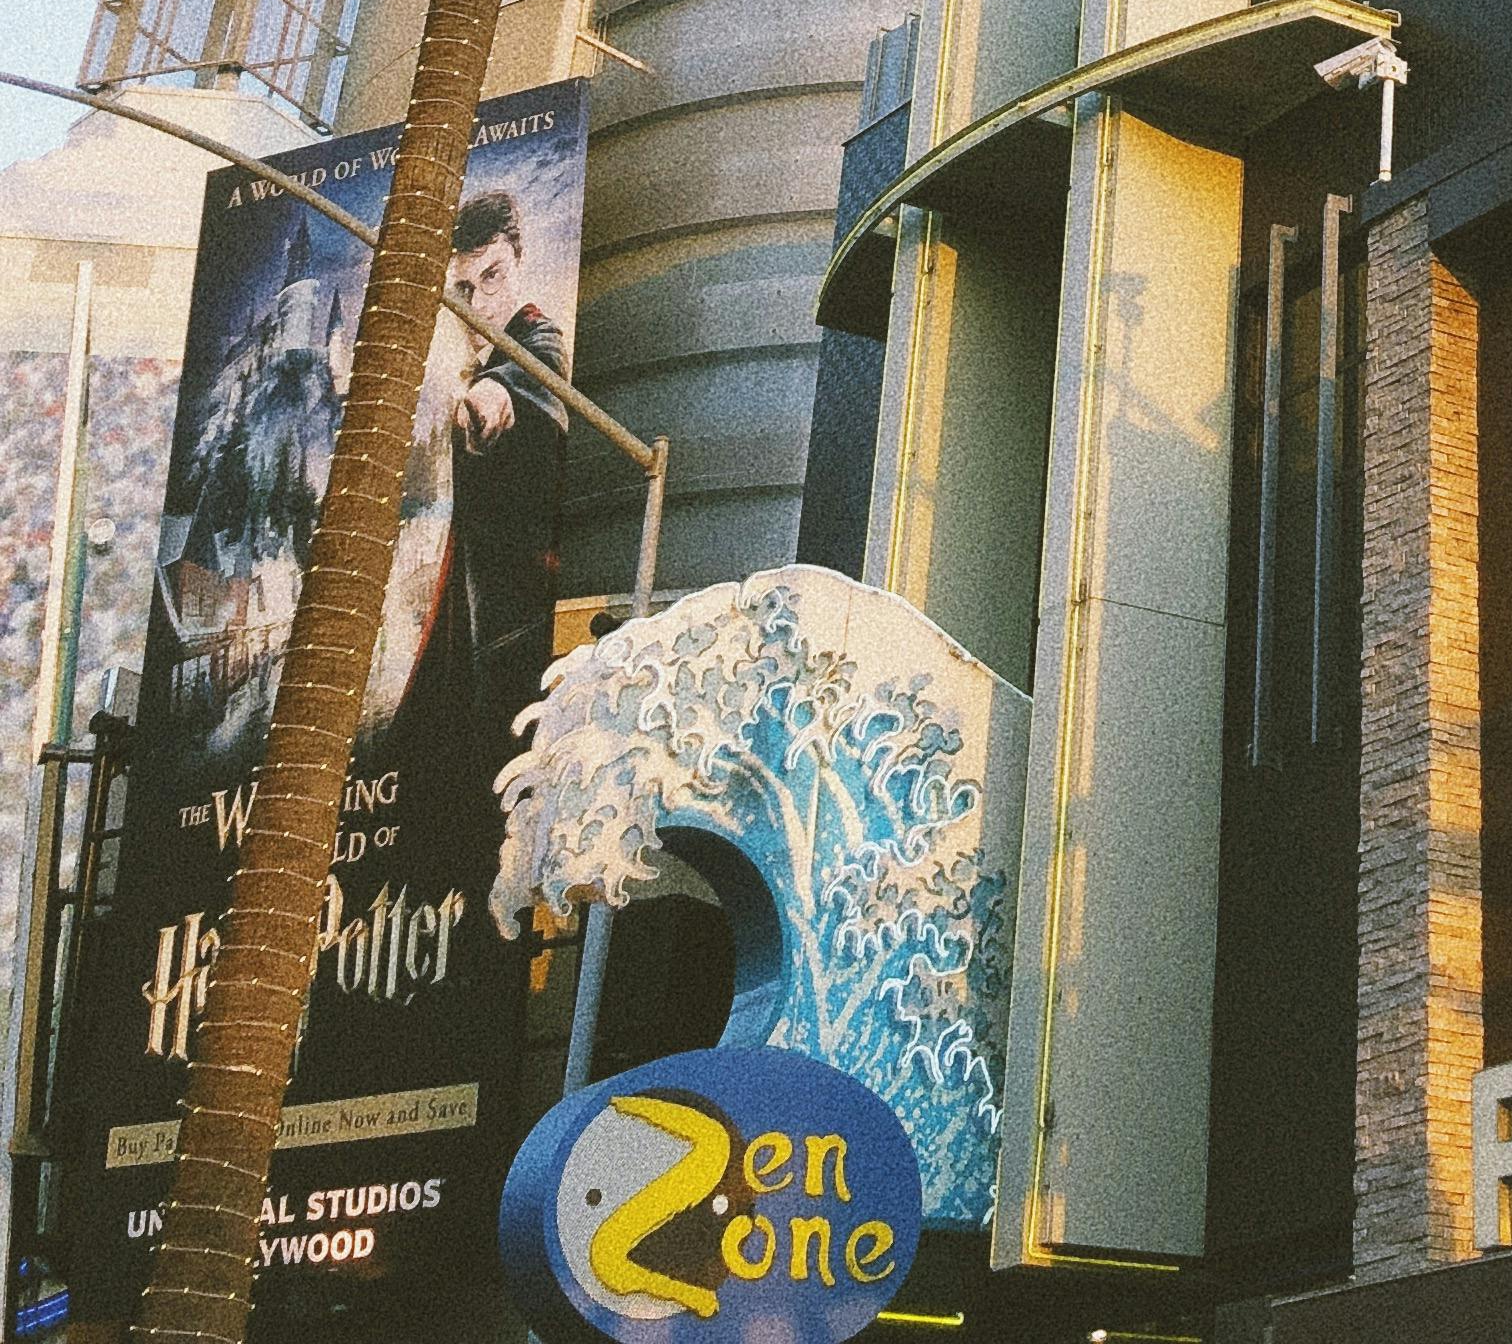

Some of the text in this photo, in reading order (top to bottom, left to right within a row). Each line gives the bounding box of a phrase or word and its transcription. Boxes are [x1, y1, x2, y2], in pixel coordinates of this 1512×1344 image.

[226, 186, 243, 209] A
[250, 167, 327, 201] WOLD
[334, 157, 363, 180] OF
[475, 110, 555, 148] AWAITS
[179, 804, 212, 828] THE
[374, 825, 400, 848] OF
[116, 1136, 147, 1160] Buy
[339, 1110, 380, 1130] Now
[386, 1100, 419, 1125] and
[306, 1178, 442, 1222] STUDIOS
